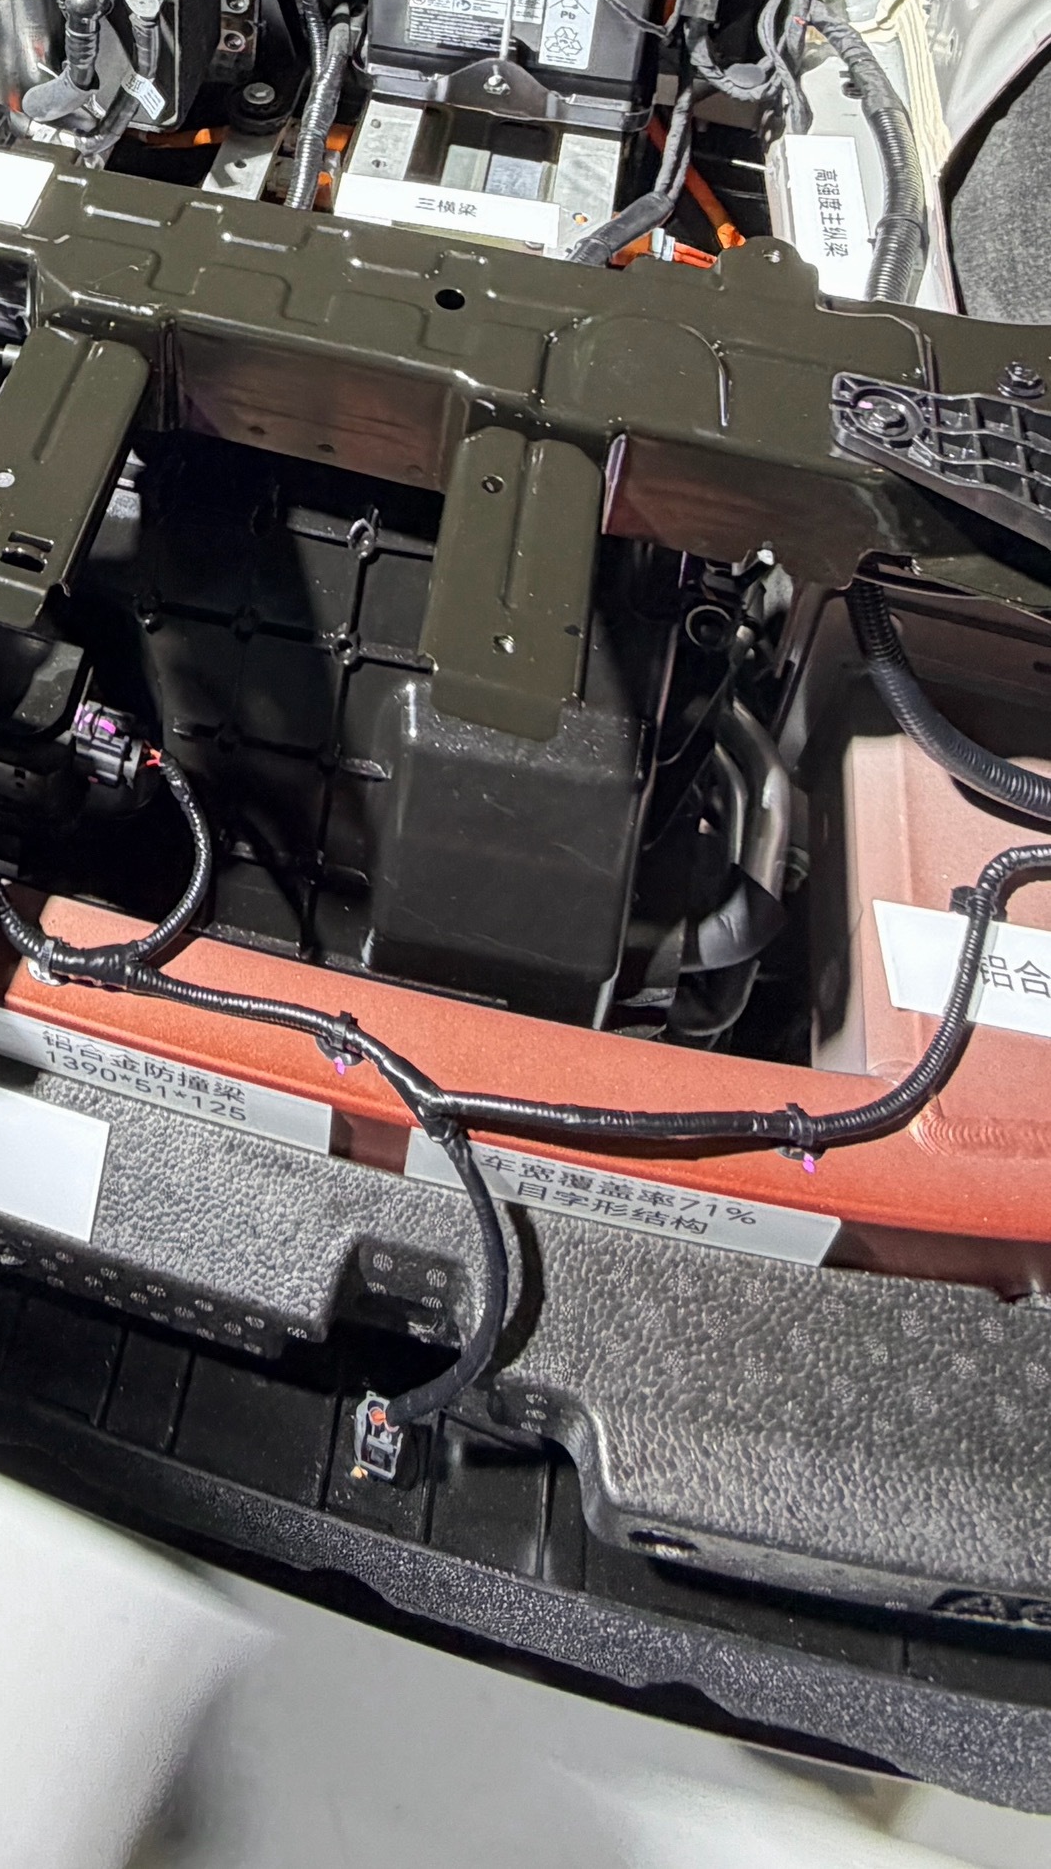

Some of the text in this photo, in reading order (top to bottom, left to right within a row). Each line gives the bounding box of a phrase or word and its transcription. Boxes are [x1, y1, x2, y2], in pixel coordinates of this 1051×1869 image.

[560, 10, 576, 20] Pb
[414, 197, 478, 218] 三横梁
[812, 168, 849, 258] 高强度主纵梁
[42, 1030, 246, 1105] 铝合金防撞梁
[480, 1153, 757, 1226] 车宽覆盖率71%
[517, 1180, 709, 1235] 目字形结构
